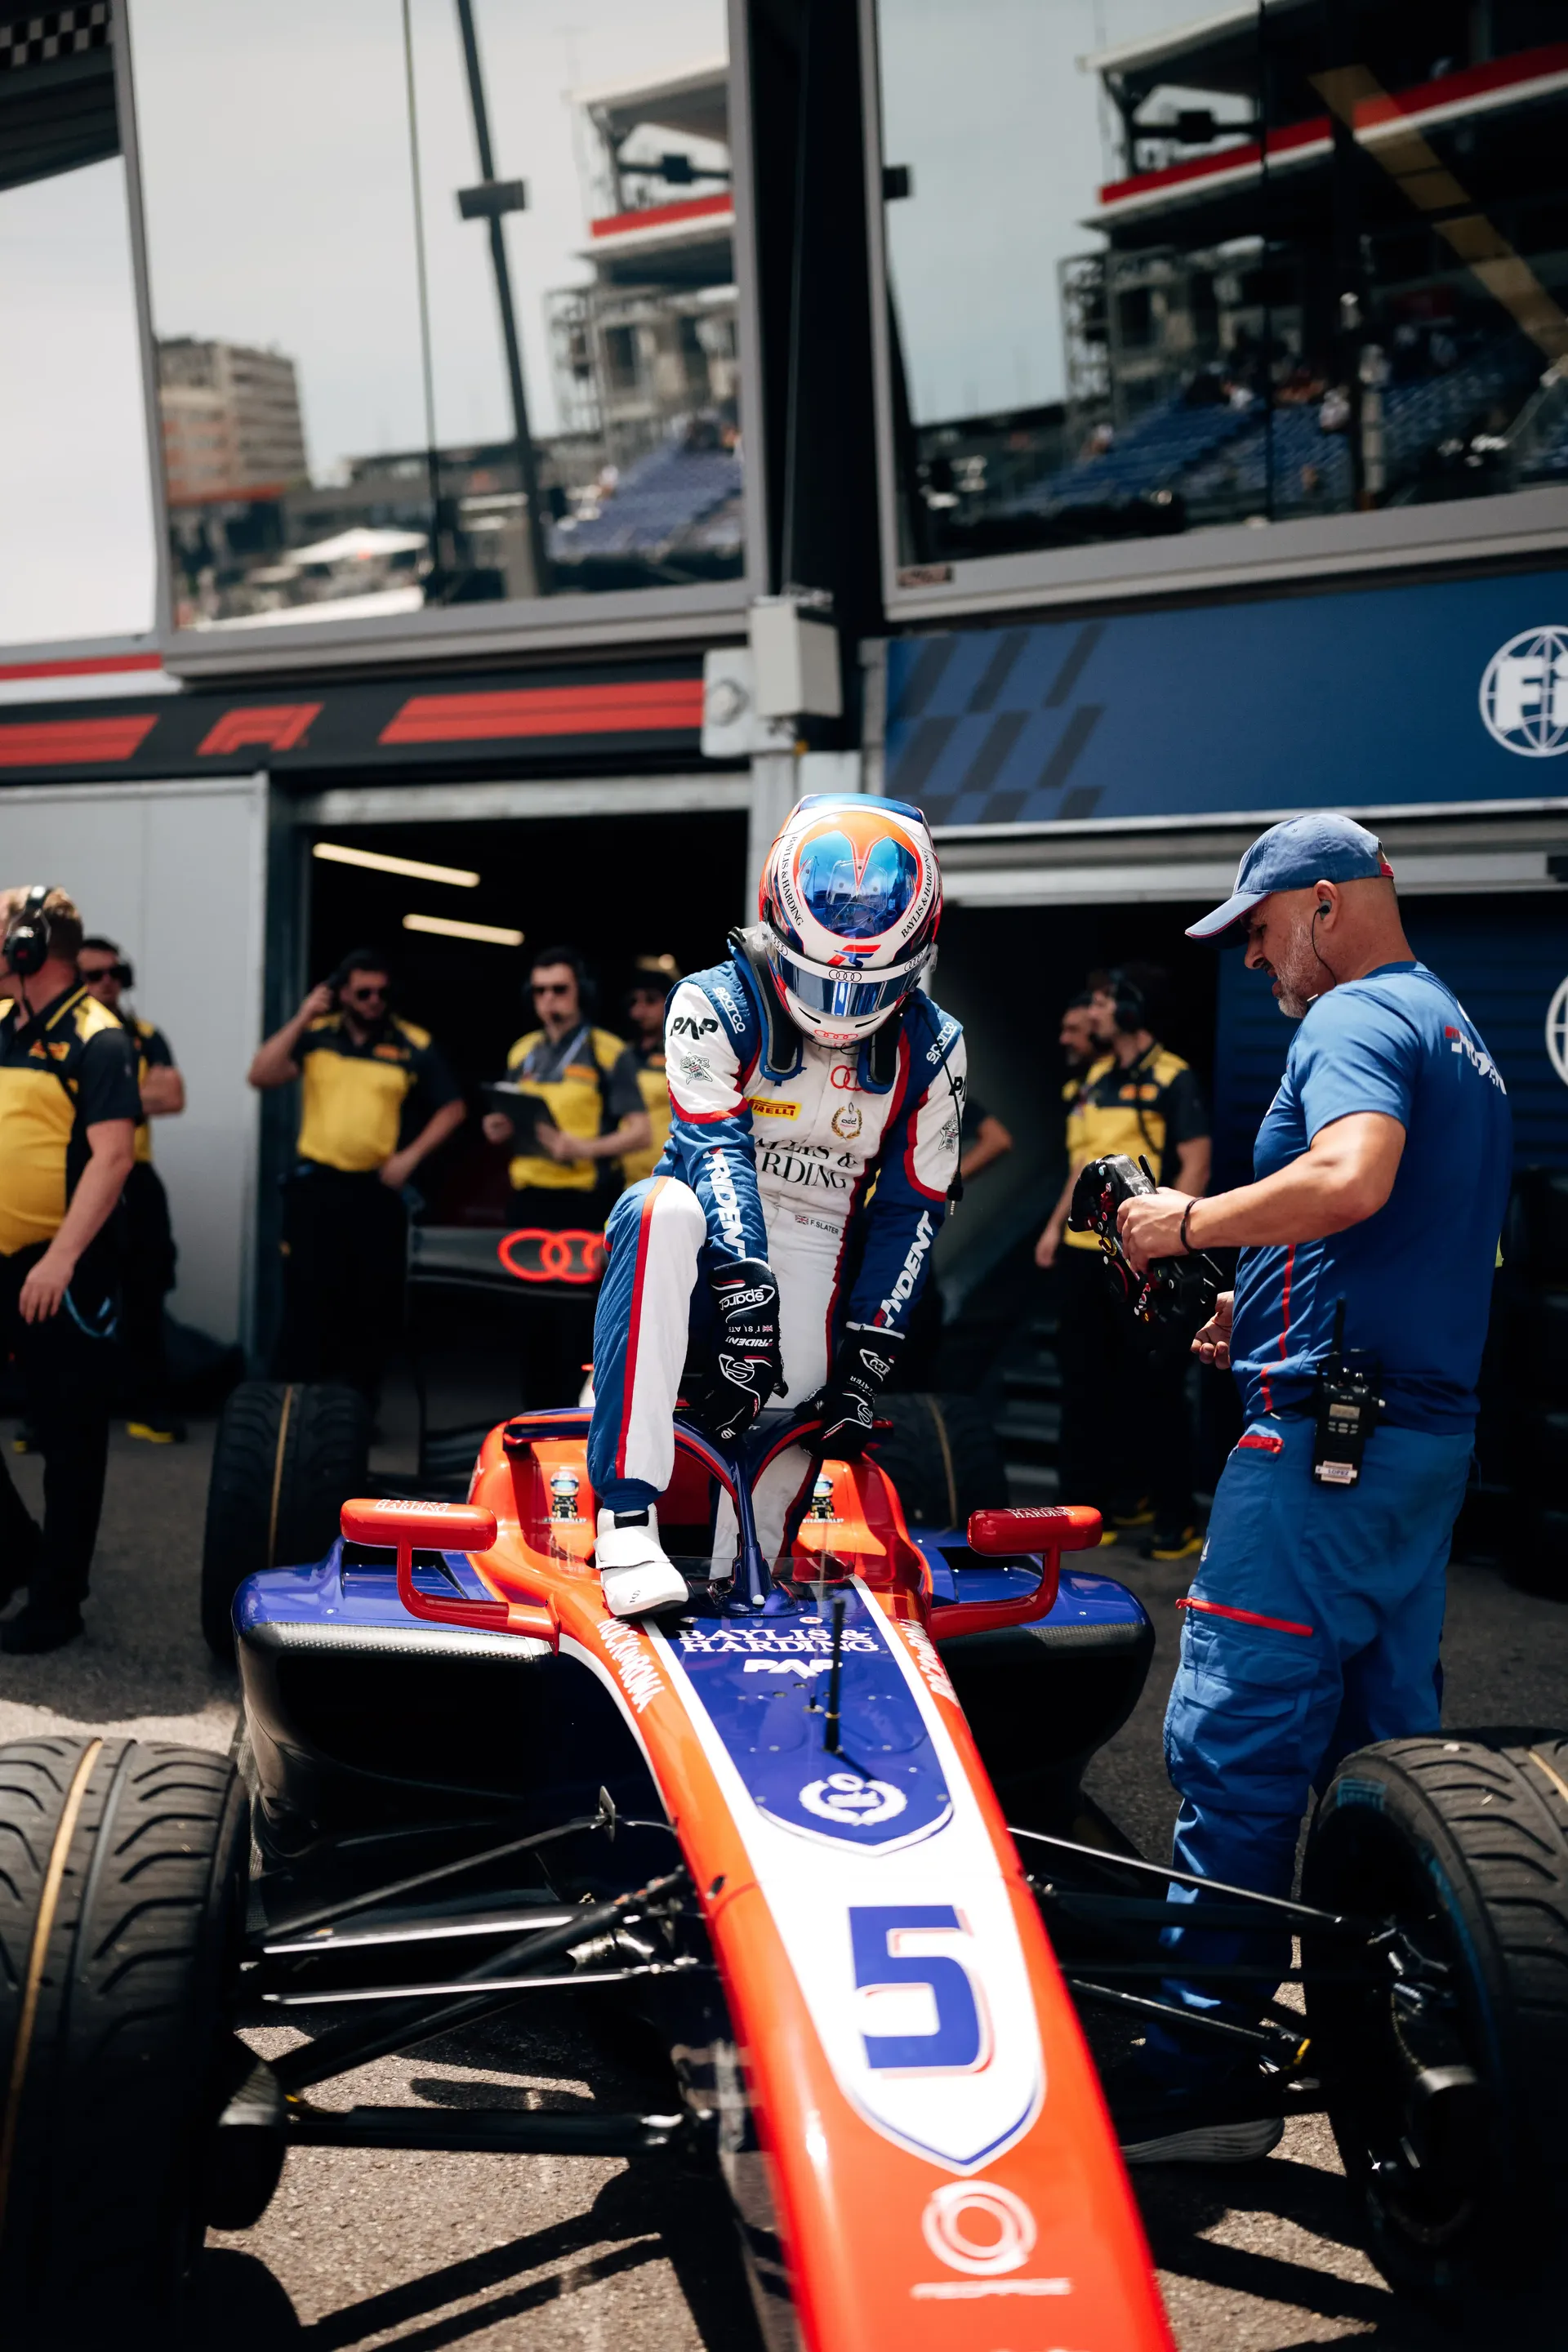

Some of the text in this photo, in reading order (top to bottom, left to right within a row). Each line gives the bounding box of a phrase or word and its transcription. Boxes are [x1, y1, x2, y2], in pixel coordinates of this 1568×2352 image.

[782, 880, 804, 926] HARDING
[901, 905, 924, 938] BAYLIS
[920, 897, 928, 906] &
[712, 987, 746, 1034] sparco
[926, 1021, 957, 1065] sparco
[761, 1152, 847, 1188] RDING
[676, 1629, 872, 1641] BAYLIS &
[679, 1640, 879, 1652] HARDING
[848, 1904, 990, 2076] 5
